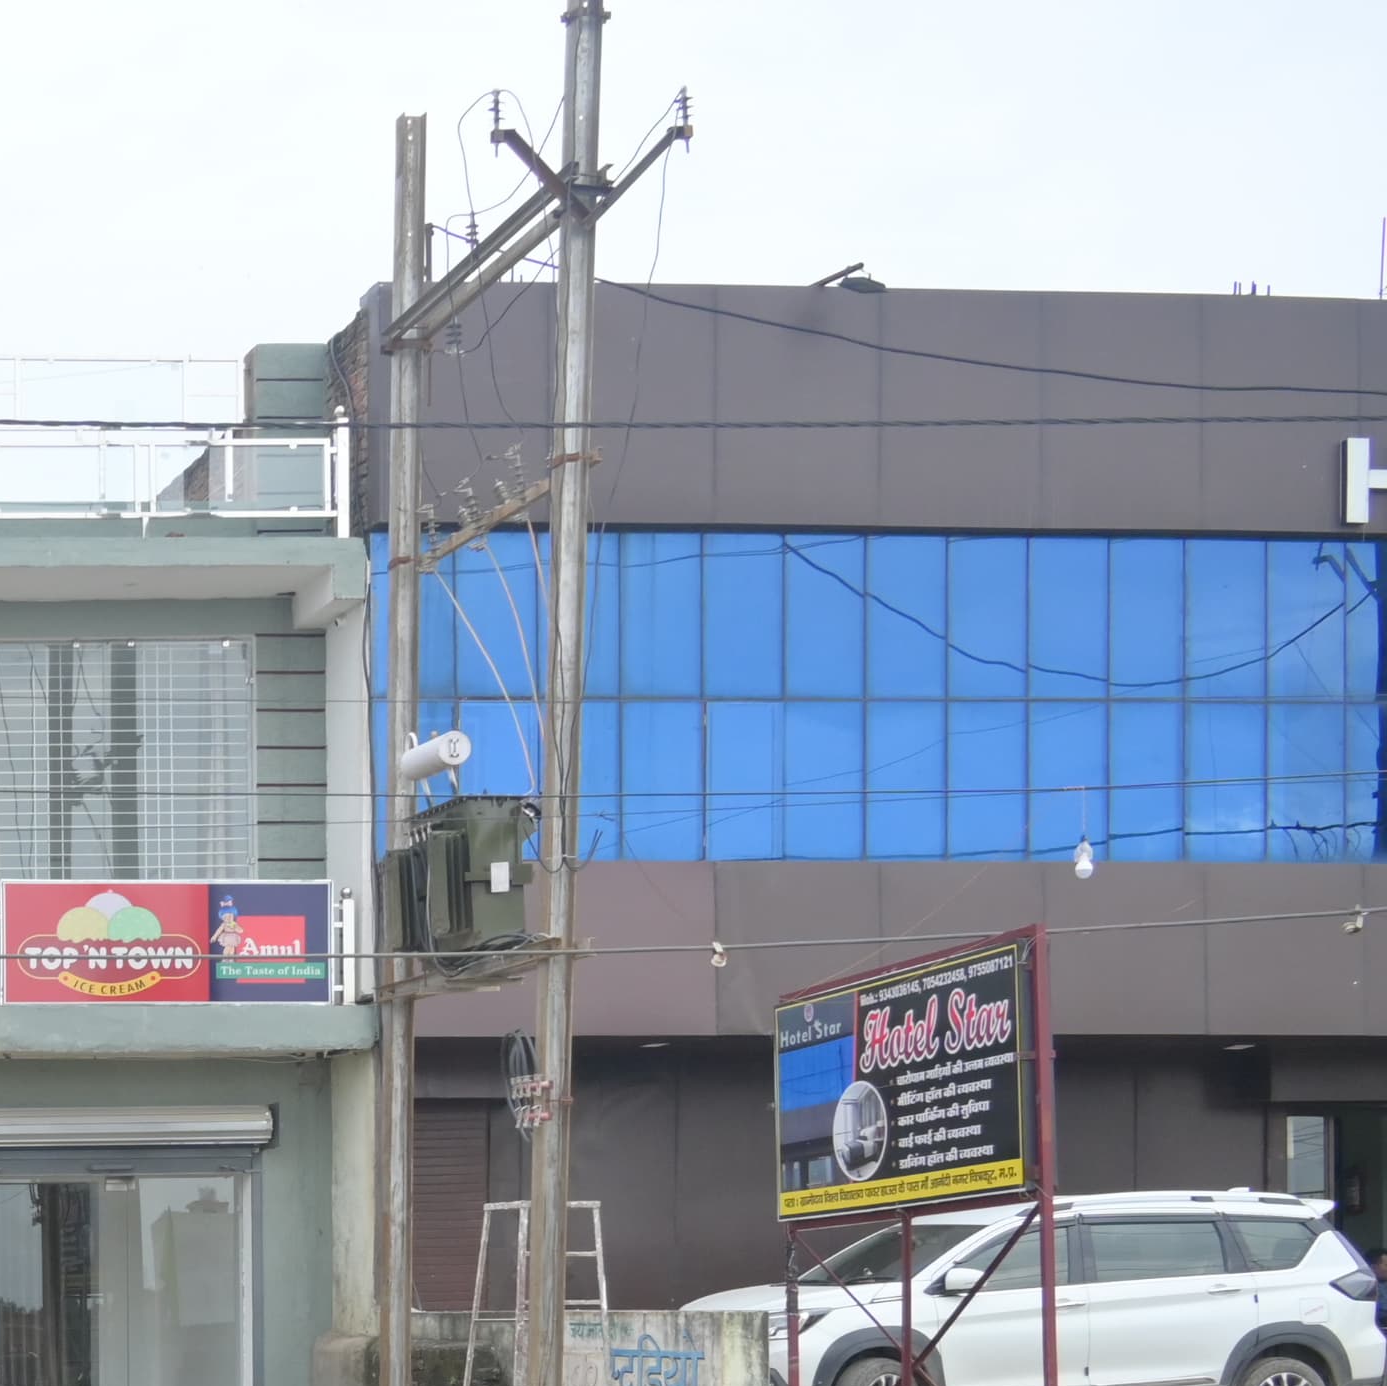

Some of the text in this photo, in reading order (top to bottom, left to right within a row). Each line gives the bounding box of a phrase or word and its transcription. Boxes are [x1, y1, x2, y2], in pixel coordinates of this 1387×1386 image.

[239, 937, 301, 957] Amul
[25, 946, 78, 970] TOP
[110, 946, 193, 970] TOWN
[220, 965, 321, 975] The Taste of India
[73, 979, 146, 994] ICE CREAM
[780, 1021, 842, 1048] Hotel Star
[859, 988, 1012, 1073] Hotel Star
[952, 1060, 963, 1074] की
[943, 1082, 956, 1097] की
[957, 1079, 992, 1094] व्यवस्था
[947, 1102, 959, 1117] की
[933, 1127, 946, 1142] की
[947, 1125, 982, 1139] व्यवस्था
[945, 1147, 958, 1161] की
[959, 1145, 994, 1159] व्यवस्था
